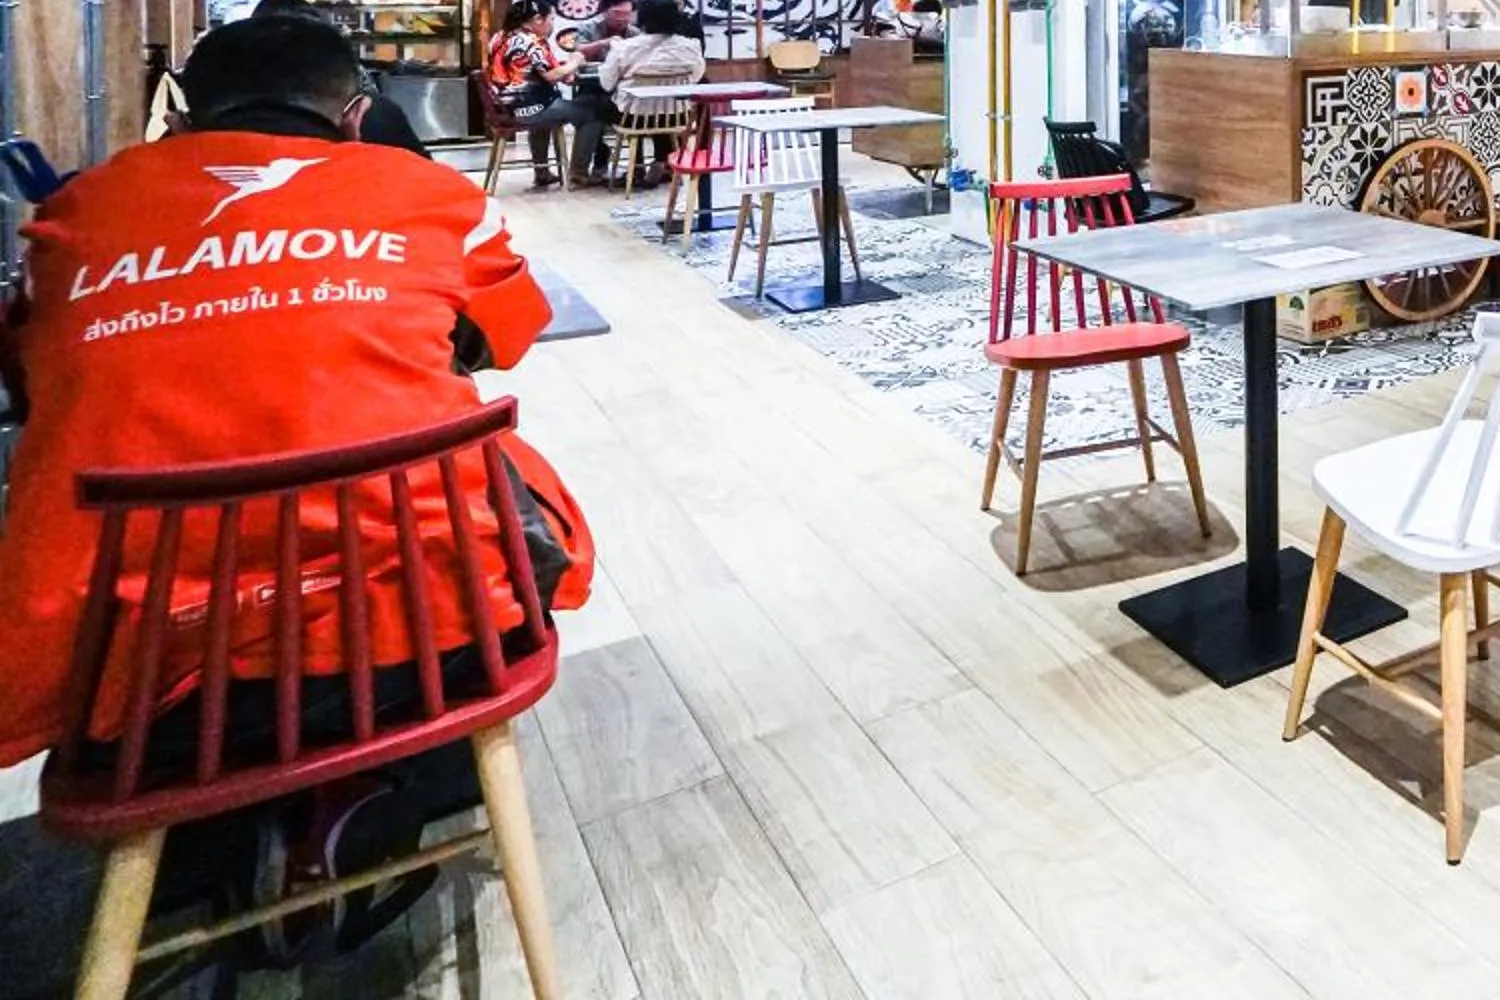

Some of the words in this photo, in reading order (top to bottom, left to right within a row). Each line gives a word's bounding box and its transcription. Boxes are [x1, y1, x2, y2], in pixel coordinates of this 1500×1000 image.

[68, 228, 408, 303] LALAMOVE
[82, 301, 186, 343] ส่งถึงไว
[192, 286, 279, 321] ภายใน
[287, 287, 304, 305] 1
[312, 276, 389, 303] ชั่วโมง
